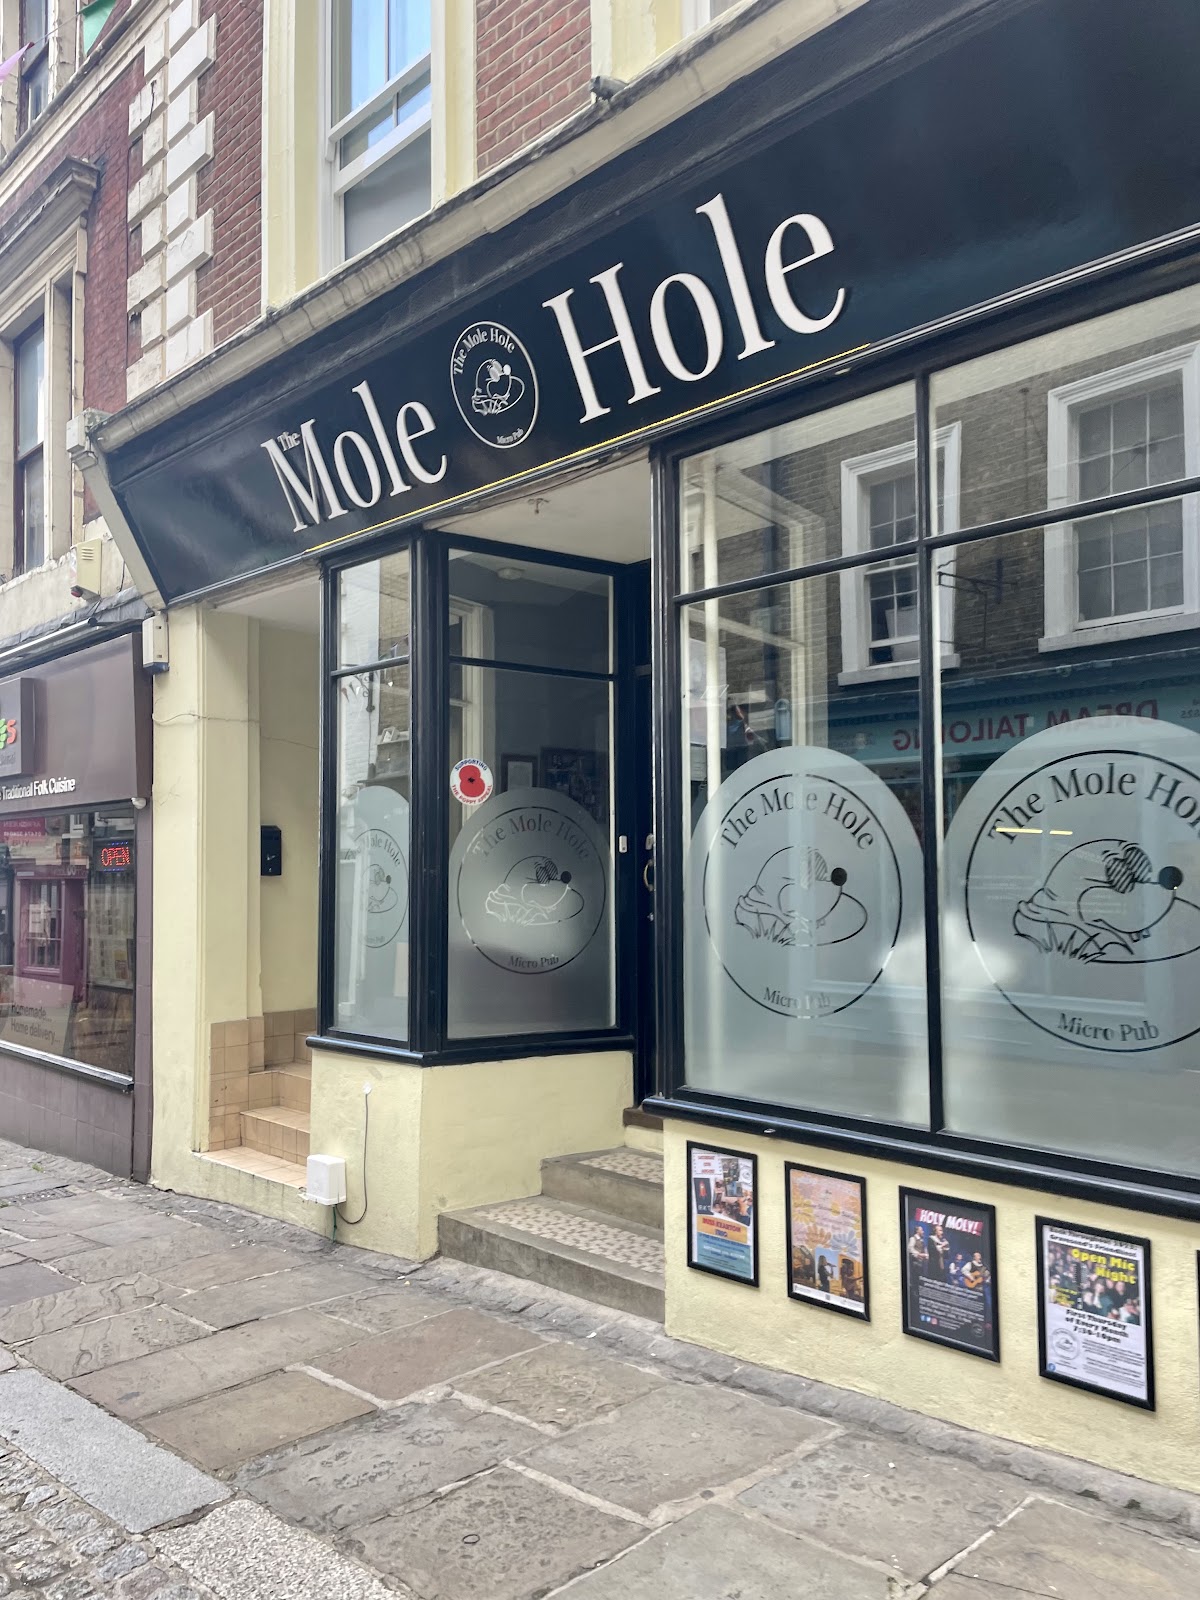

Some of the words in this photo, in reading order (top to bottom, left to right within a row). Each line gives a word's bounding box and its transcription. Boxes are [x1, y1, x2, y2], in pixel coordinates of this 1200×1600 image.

[542, 193, 846, 424] Hole
[453, 348, 468, 375] The
[462, 328, 488, 352] Mole
[490, 327, 515, 354] Hole
[277, 431, 300, 451] The
[497, 433, 514, 444] Micro
[512, 427, 524, 440] Pub
[261, 381, 447, 532] Mole
[2, 782, 34, 800] Traditional
[33, 780, 49, 796] Folk
[48, 777, 76, 794] Cuisine
[452, 784, 460, 796] THE
[459, 795, 477, 804] POPPY
[478, 785, 493, 803] APPEAL
[987, 792, 1045, 845] The
[1048, 762, 1137, 804] Mole
[1144, 772, 1200, 840] Ho
[720, 807, 759, 850] The
[760, 787, 818, 816] Moe
[822, 791, 875, 851] Hole
[472, 827, 507, 858] The
[510, 813, 552, 835] Mole
[556, 821, 590, 860] Hole
[101, 847, 131, 866] OPEN
[384, 838, 401, 868] Hole
[508, 955, 538, 969] Micro
[540, 954, 560, 968] Pub
[11, 1017, 29, 1035] Home
[1057, 1012, 1115, 1041] Micro
[1119, 1020, 1160, 1041] Pub
[920, 1209, 946, 1225] HOLY
[945, 1216, 979, 1235] MOLY!
[1071, 1248, 1107, 1265] Open
[1110, 1256, 1136, 1271] Mic
[1095, 1266, 1137, 1285] Night
[1066, 1309, 1086, 1320] First
[1087, 1314, 1127, 1331] Thursday
[1075, 1318, 1099, 1331] Every
[1101, 1325, 1129, 1338] Month
